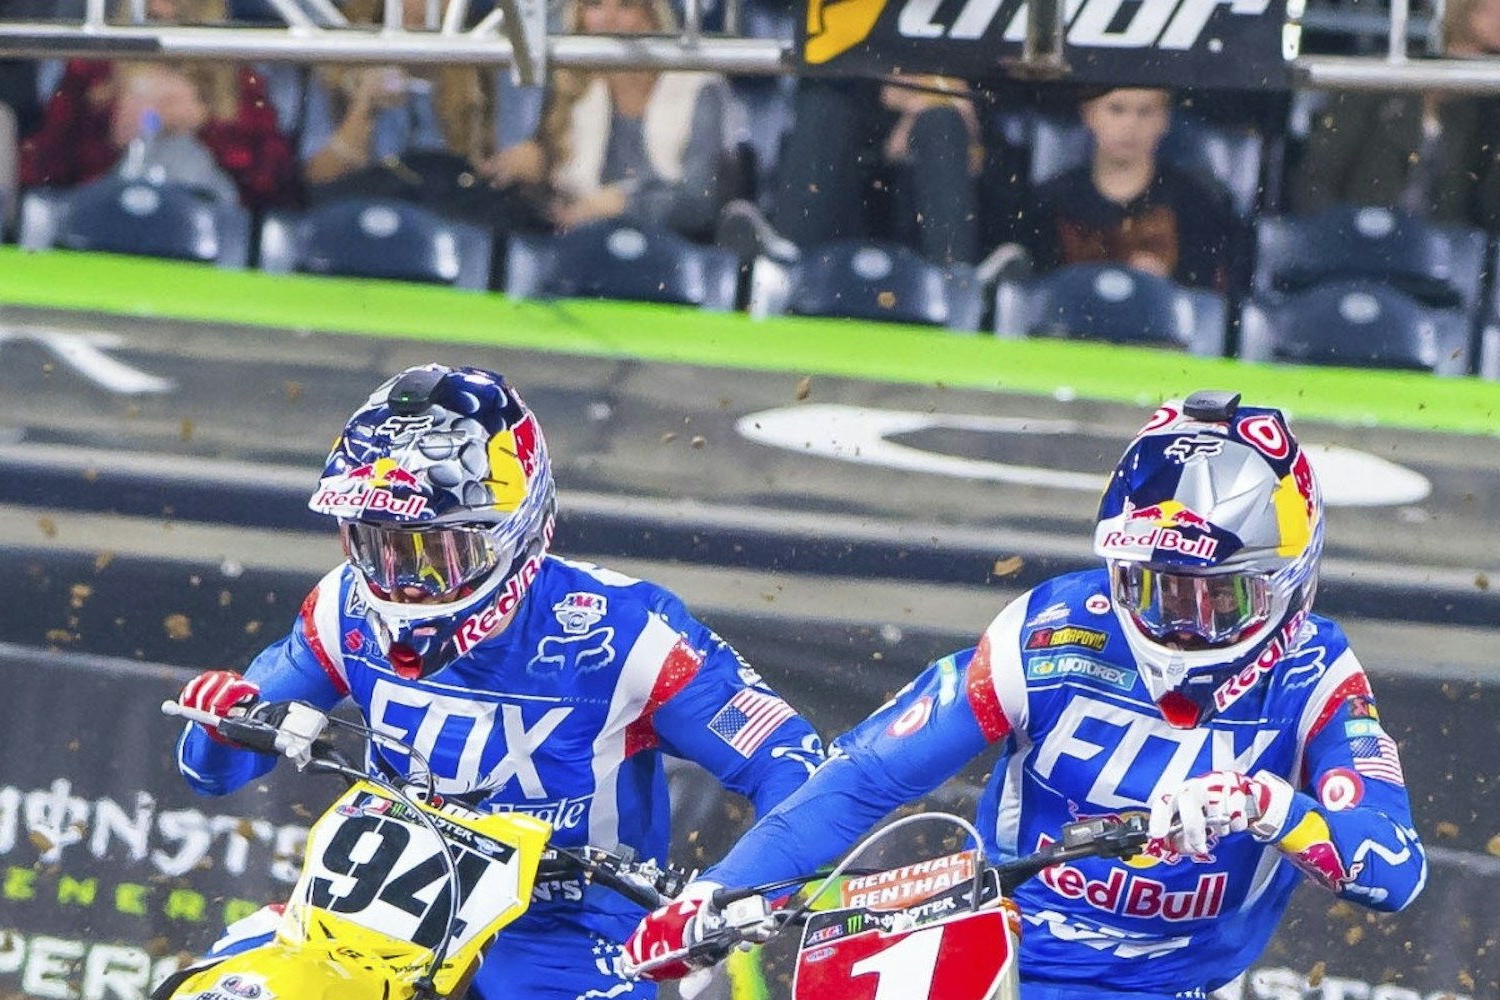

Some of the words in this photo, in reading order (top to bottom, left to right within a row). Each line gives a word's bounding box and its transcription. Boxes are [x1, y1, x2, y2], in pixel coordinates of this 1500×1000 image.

[317, 489, 369, 507] Red
[369, 488, 427, 519] Bull
[1103, 531, 1161, 550] Red
[1159, 532, 1217, 561] Bull
[454, 578, 521, 655] Red
[1057, 656, 1126, 686] MOTOREX
[1214, 637, 1286, 713] Red
[367, 677, 575, 801] FOX
[304, 814, 493, 950] 94
[848, 852, 966, 892] RENTHAL
[1125, 872, 1229, 921] Bull
